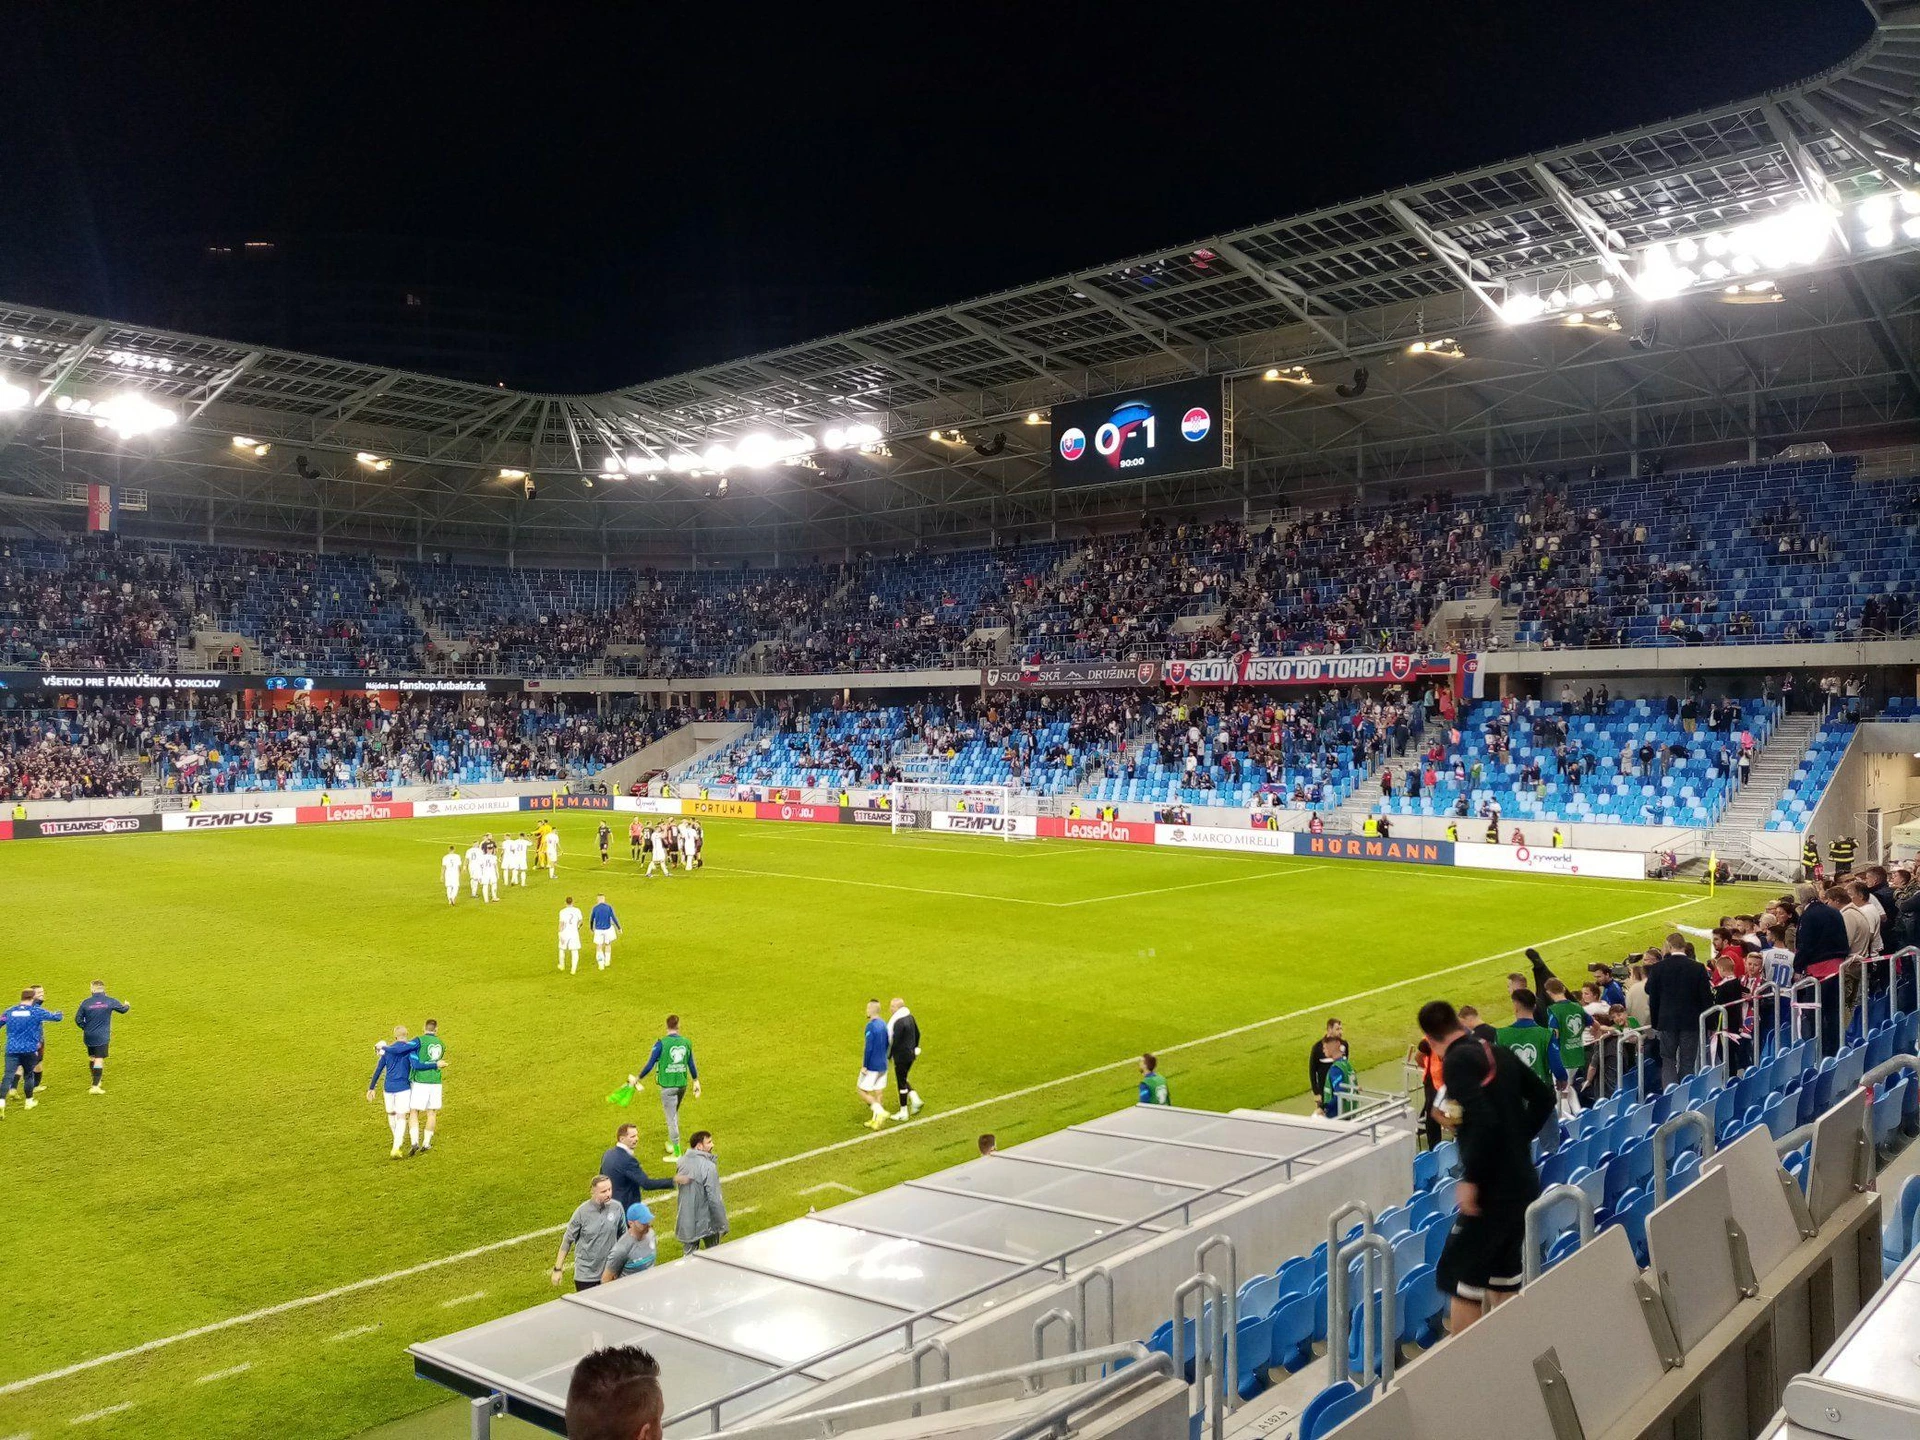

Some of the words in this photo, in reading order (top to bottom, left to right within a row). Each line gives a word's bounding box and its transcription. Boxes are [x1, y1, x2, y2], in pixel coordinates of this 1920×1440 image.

[1120, 457, 1145, 468] 90:00
[1087, 666, 1137, 680] DRUŽINA
[1190, 657, 1292, 683] SLOVNSKO
[1295, 657, 1320, 680] DO
[1327, 653, 1385, 679] TOHO!
[42, 675, 83, 687] VŠETKO
[86, 678, 104, 687] PRE
[107, 674, 172, 688] FANÚŠIKA
[174, 679, 221, 688] SOKOLOV
[399, 680, 487, 692] fanshop.futbalsfz.sk
[445, 803, 476, 811] MARCO
[478, 801, 510, 810] MIRELLI
[530, 796, 609, 808] HÖRMANN
[695, 803, 743, 815] FORTUNA
[185, 812, 273, 827] TEMPUS
[327, 805, 390, 821] LeasePlan
[41, 818, 138, 835] 11TEAMSPORTS
[948, 815, 1017, 832] TEMPUS
[1064, 820, 1129, 841] LeasePlan
[1192, 833, 1232, 845] MARCO
[1235, 835, 1279, 847] MIRELLI
[1311, 838, 1438, 860] HÖRMANN
[1772, 963, 1790, 987] 10
